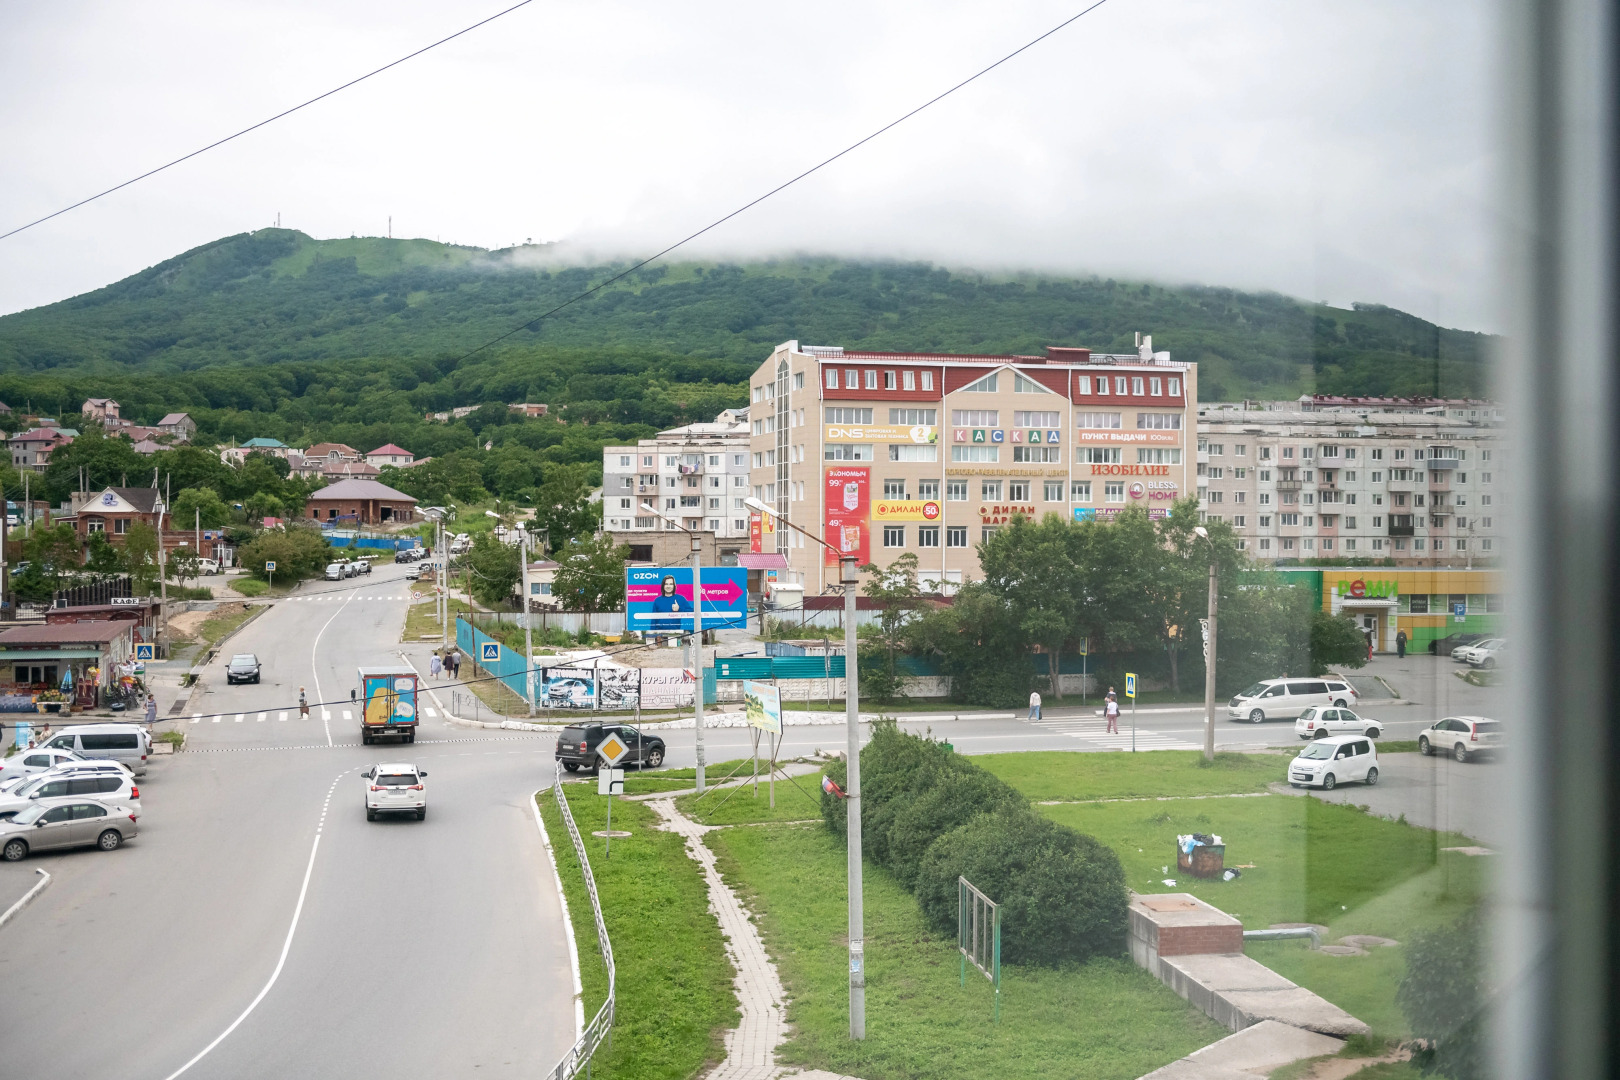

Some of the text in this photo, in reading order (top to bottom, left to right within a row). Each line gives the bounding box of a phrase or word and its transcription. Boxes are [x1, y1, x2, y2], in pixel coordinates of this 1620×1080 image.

[828, 428, 863, 438] DNS
[917, 428, 924, 438] 2
[956, 430, 1059, 443] КАСКАД
[1110, 433, 1147, 441] ВЫДАЧИ
[1090, 464, 1170, 476] ИЗОБИЛИЕ
[1148, 491, 1178, 500] HOME
[890, 505, 921, 514] ДИЛАН
[992, 505, 1035, 515] ДИЛАН
[982, 516, 1032, 524] МАРТ
[633, 572, 659, 580] OZON
[642, 676, 667, 685] КУРЫ
